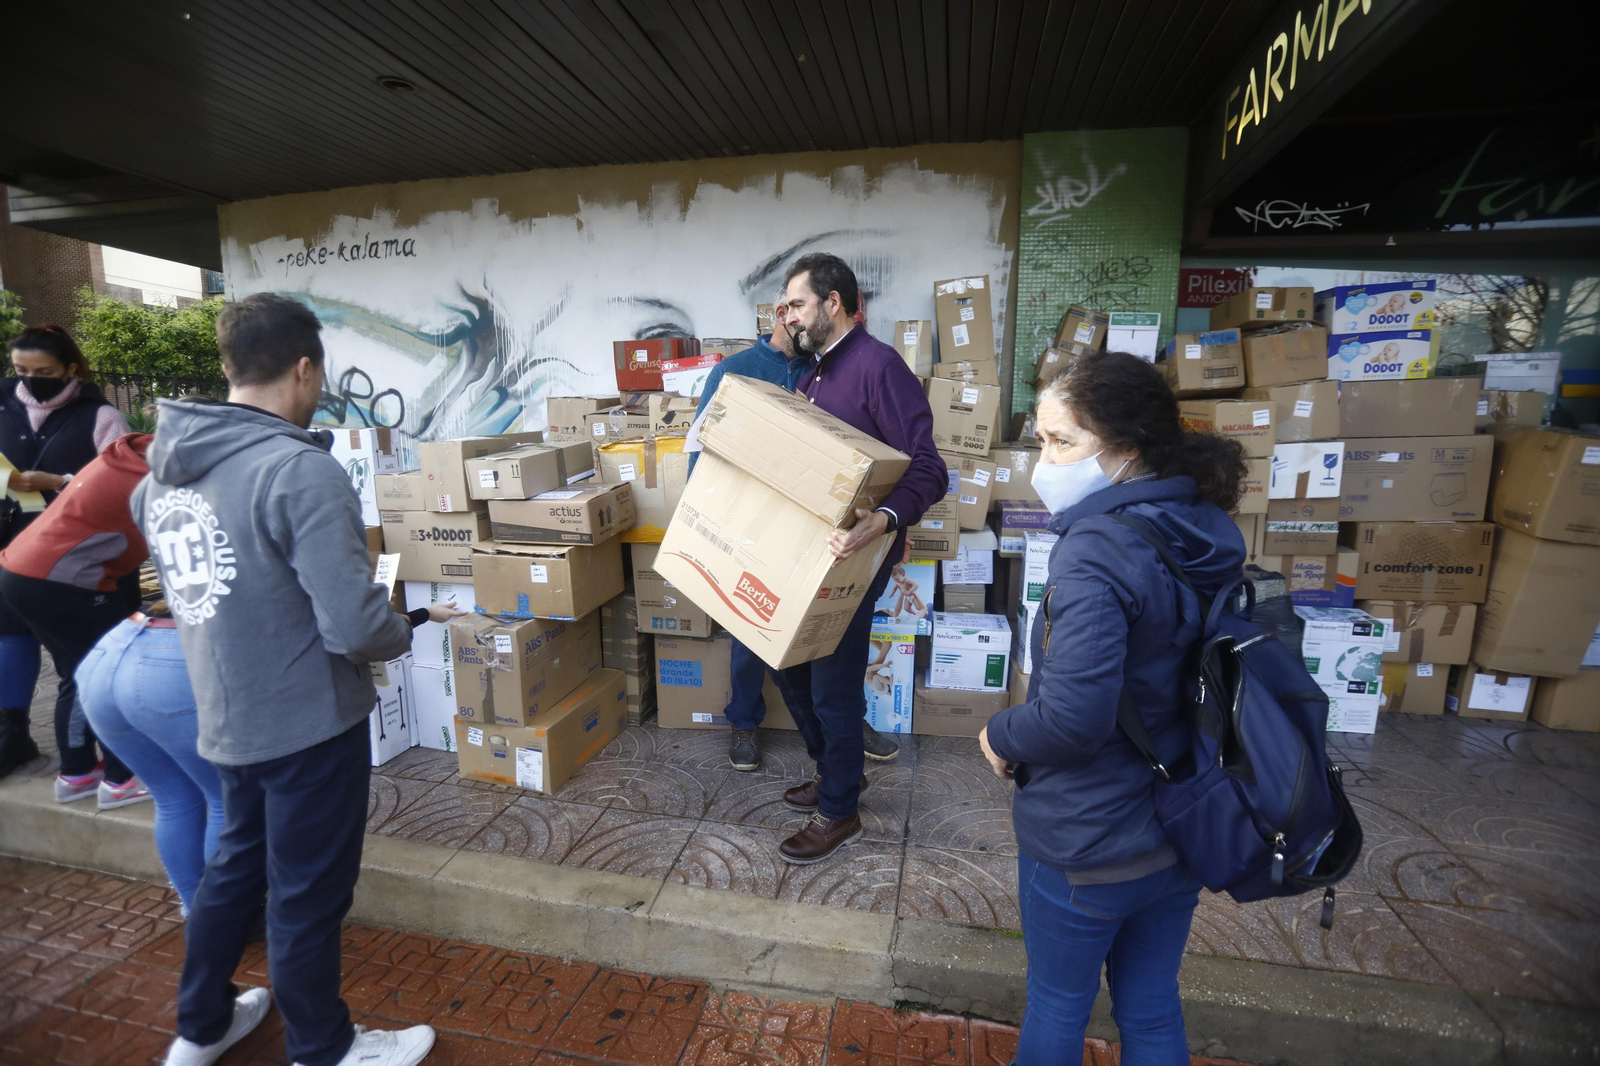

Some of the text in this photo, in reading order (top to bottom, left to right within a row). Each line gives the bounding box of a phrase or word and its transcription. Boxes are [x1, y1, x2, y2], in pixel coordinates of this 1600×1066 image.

[1187, 294, 1236, 304] ANTICA
[1369, 313, 1410, 325] DODOT
[1350, 321, 1358, 331] 2
[1363, 362, 1404, 374] DODOT
[1343, 369, 1351, 379] 2
[1435, 450, 1445, 458] M
[549, 506, 582, 517] actius
[432, 526, 473, 542] DODOT
[1374, 562, 1435, 573] comfort
[1437, 565, 1474, 575] zone
[737, 577, 776, 611] Berlys
[918, 618, 927, 629] 3
[545, 624, 566, 642] Pants
[658, 641, 678, 649] Pants
[458, 655, 483, 665] Pants
[659, 658, 693, 669] NOCHE
[660, 668, 694, 677] Grande
[460, 706, 475, 717] 80
[528, 703, 539, 717] 80
